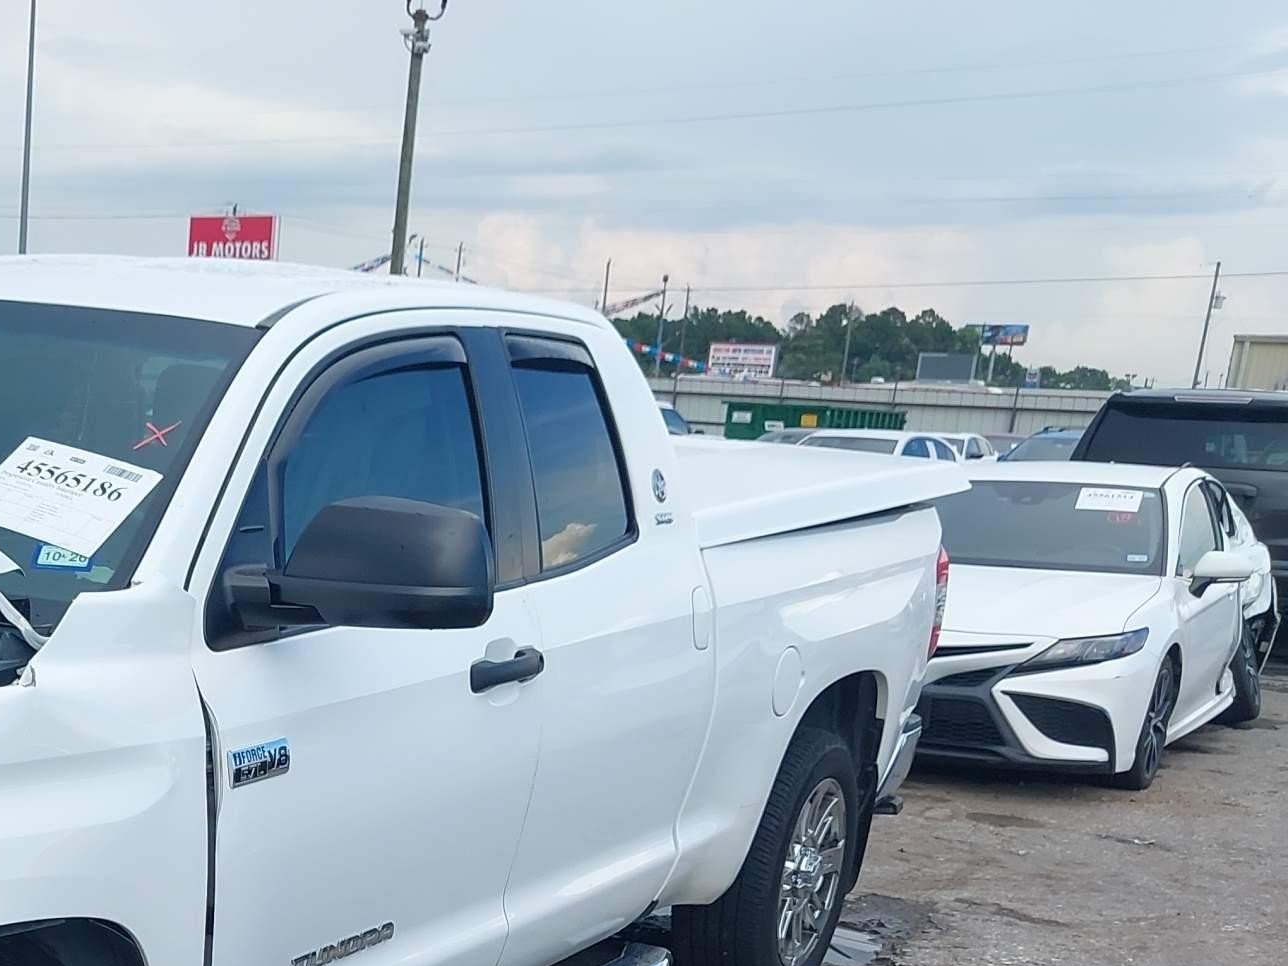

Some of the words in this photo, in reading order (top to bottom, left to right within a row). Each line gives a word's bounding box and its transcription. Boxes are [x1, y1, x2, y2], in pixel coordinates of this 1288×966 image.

[211, 240, 269, 259] MOTORS
[16, 460, 129, 502] 45565186
[45, 551, 61, 561] 10
[267, 745, 288, 769] V8
